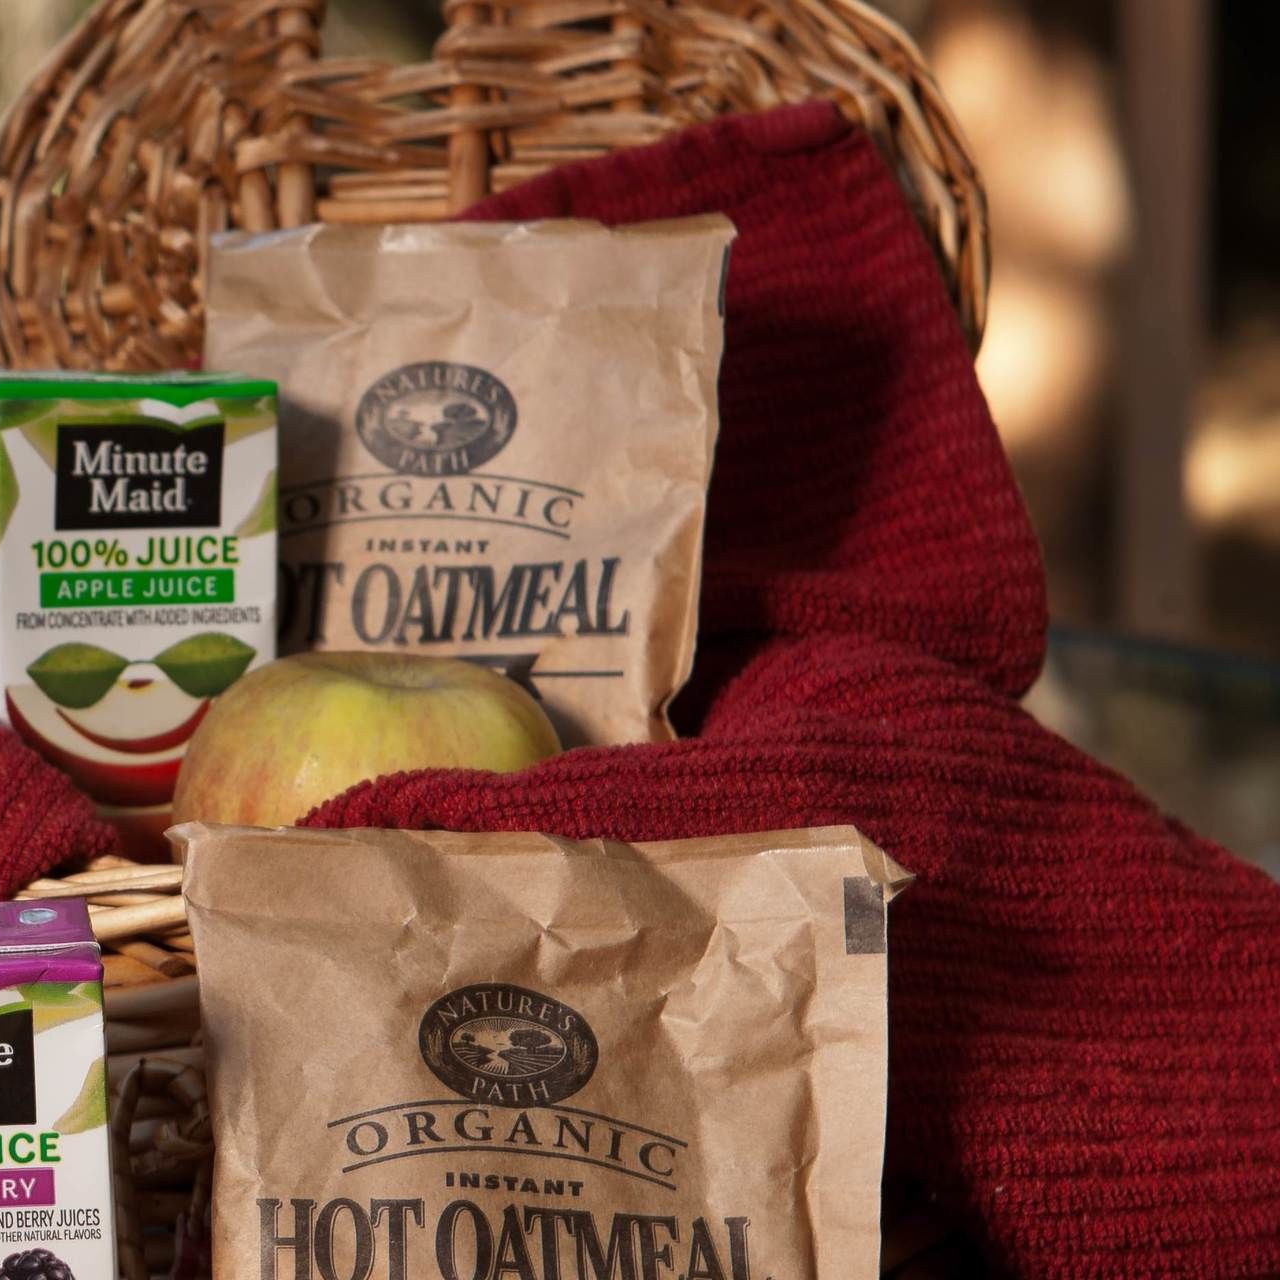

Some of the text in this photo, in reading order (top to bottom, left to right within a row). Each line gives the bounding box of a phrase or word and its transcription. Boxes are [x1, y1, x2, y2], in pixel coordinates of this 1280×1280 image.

[72, 440, 208, 475] Minute
[398, 449, 468, 472] PATH
[89, 477, 187, 512] Maid
[285, 481, 574, 528] ORGANIC
[31, 535, 240, 569] 100% JUICE
[366, 539, 490, 554] INSTANT
[57, 576, 217, 600] APPLE JUICE
[351, 557, 631, 646] OATMEAL
[16, 606, 261, 631] FROM CONCENTRATE WITH ADDED INGREDIENTS
[437, 990, 576, 1031] NATURE'S
[471, 1077, 550, 1102] PATH
[346, 1108, 676, 1177] ORGANIC
[446, 1171, 584, 1197] INSTANT
[16, 1209, 55, 1229] BERRY
[56, 1208, 100, 1227] JUICES
[24, 1229, 62, 1242] NATURAL
[64, 1228, 102, 1241] FLAVORS
